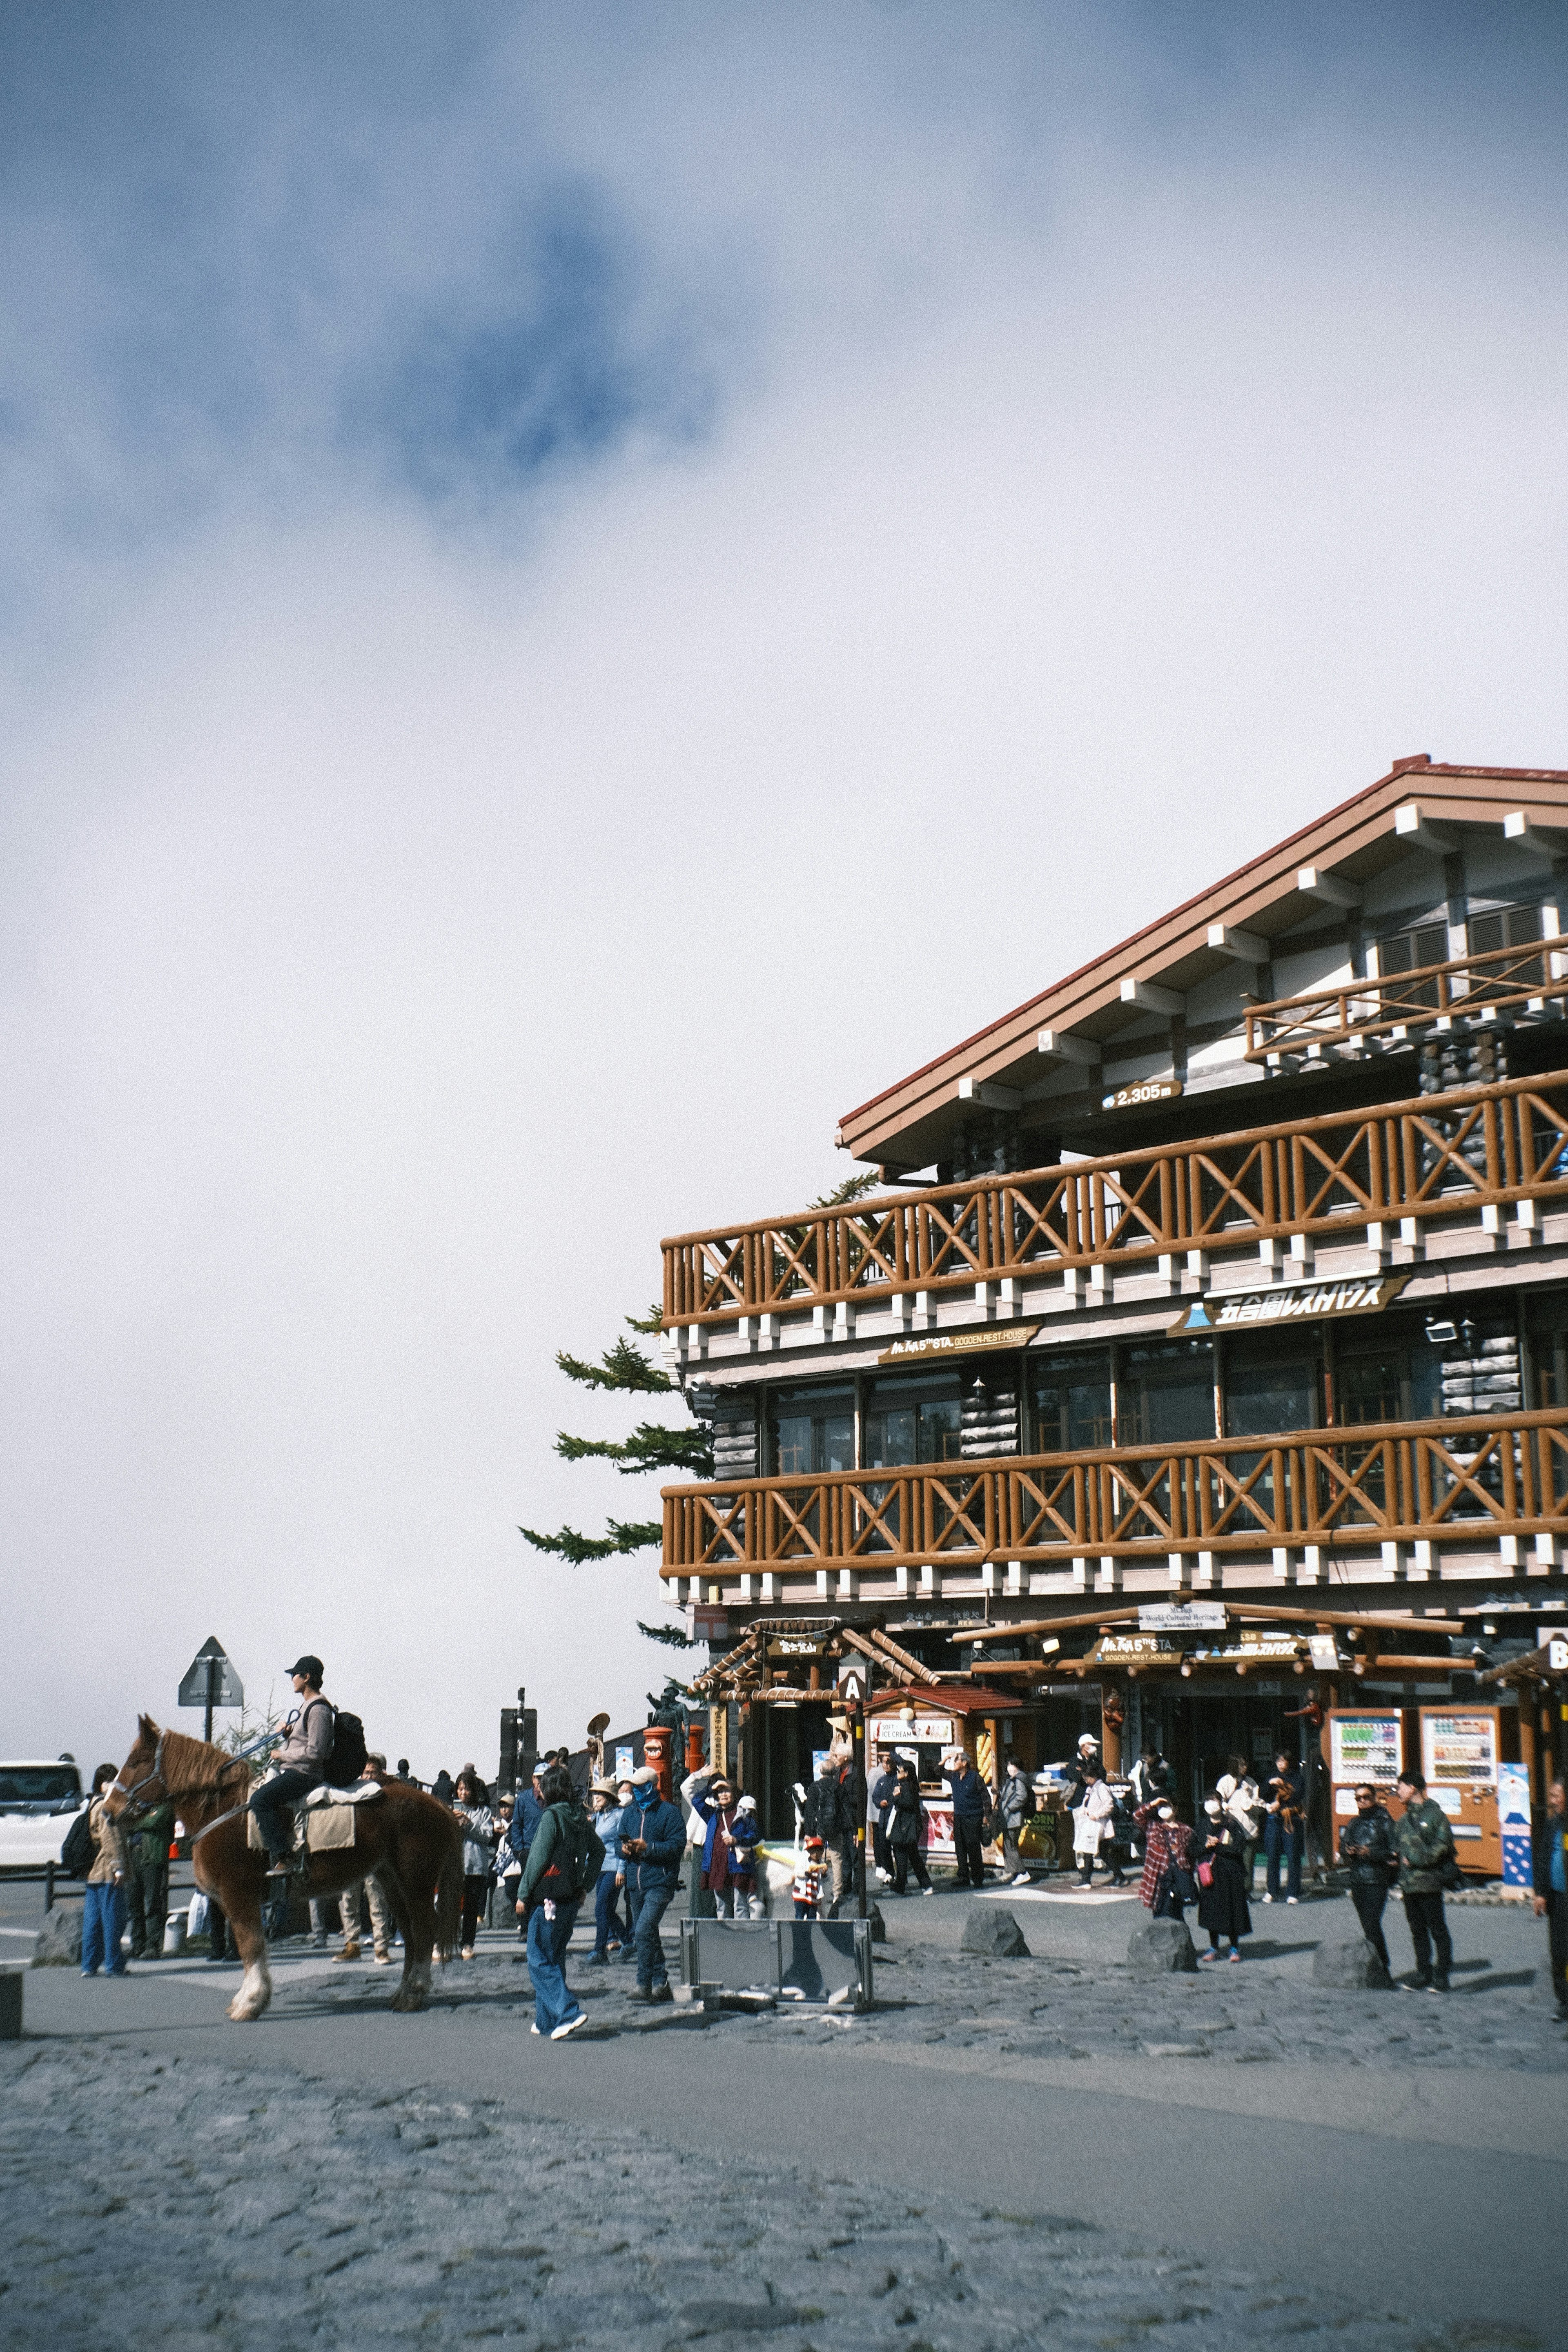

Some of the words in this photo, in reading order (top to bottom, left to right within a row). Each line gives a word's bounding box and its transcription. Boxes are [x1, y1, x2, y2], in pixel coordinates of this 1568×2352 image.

[1117, 1084, 1172, 1106] 2,305m
[1215, 1278, 1385, 1325] 五合園レストハウス
[1550, 1640, 1568, 1669] B
[845, 1677, 860, 1699] A
[1032, 1814, 1054, 1824] ORN
